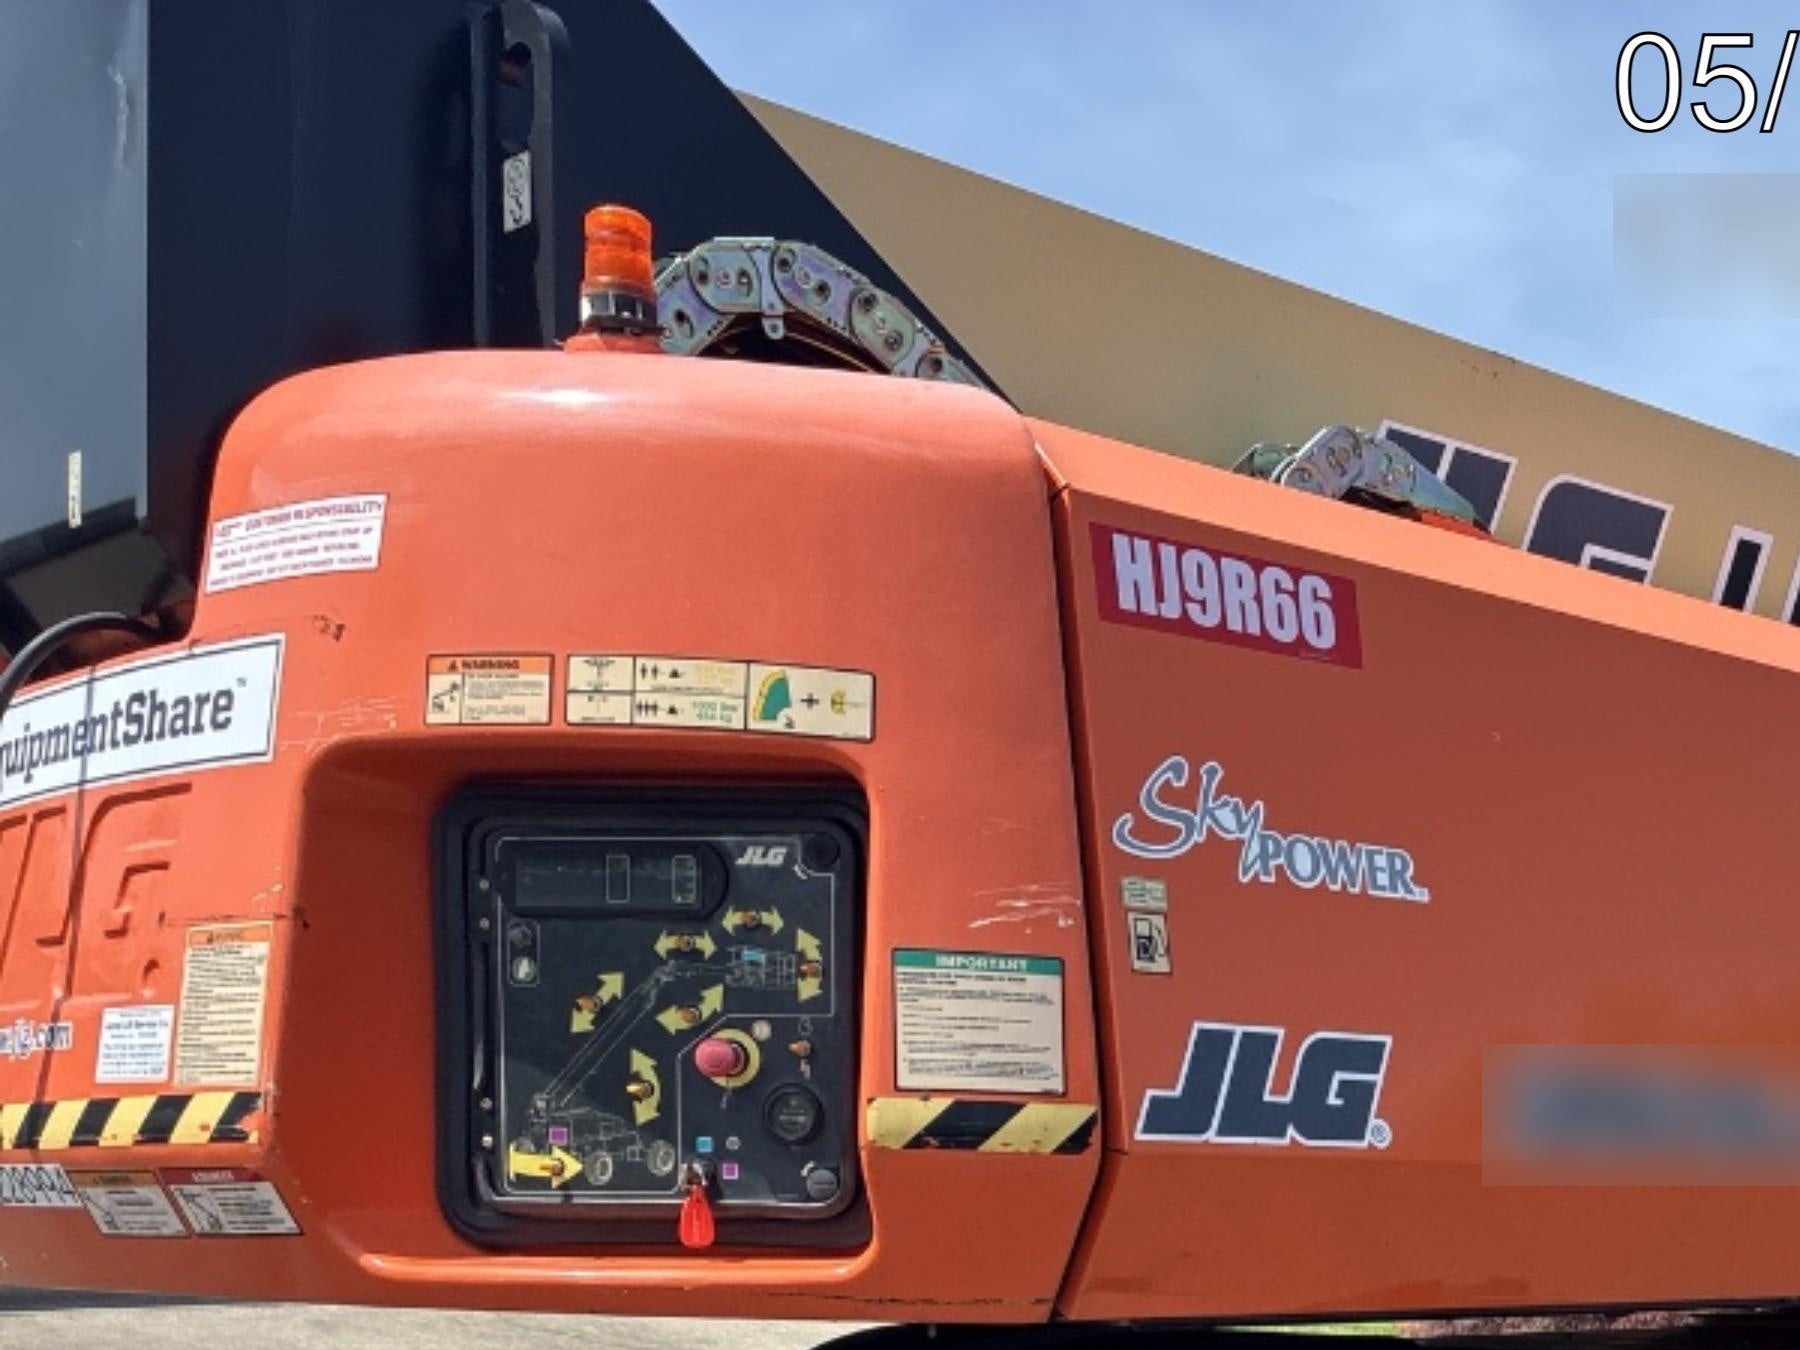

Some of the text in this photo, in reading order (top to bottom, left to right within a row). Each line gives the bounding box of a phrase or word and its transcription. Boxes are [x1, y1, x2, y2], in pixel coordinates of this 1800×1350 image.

[1382, 420, 1674, 585] LG
[1112, 533, 1337, 649] HJ9R66
[735, 847, 787, 866] JLG
[935, 953, 1028, 971] IMPORTANT
[1135, 1021, 1393, 1147] JLG
